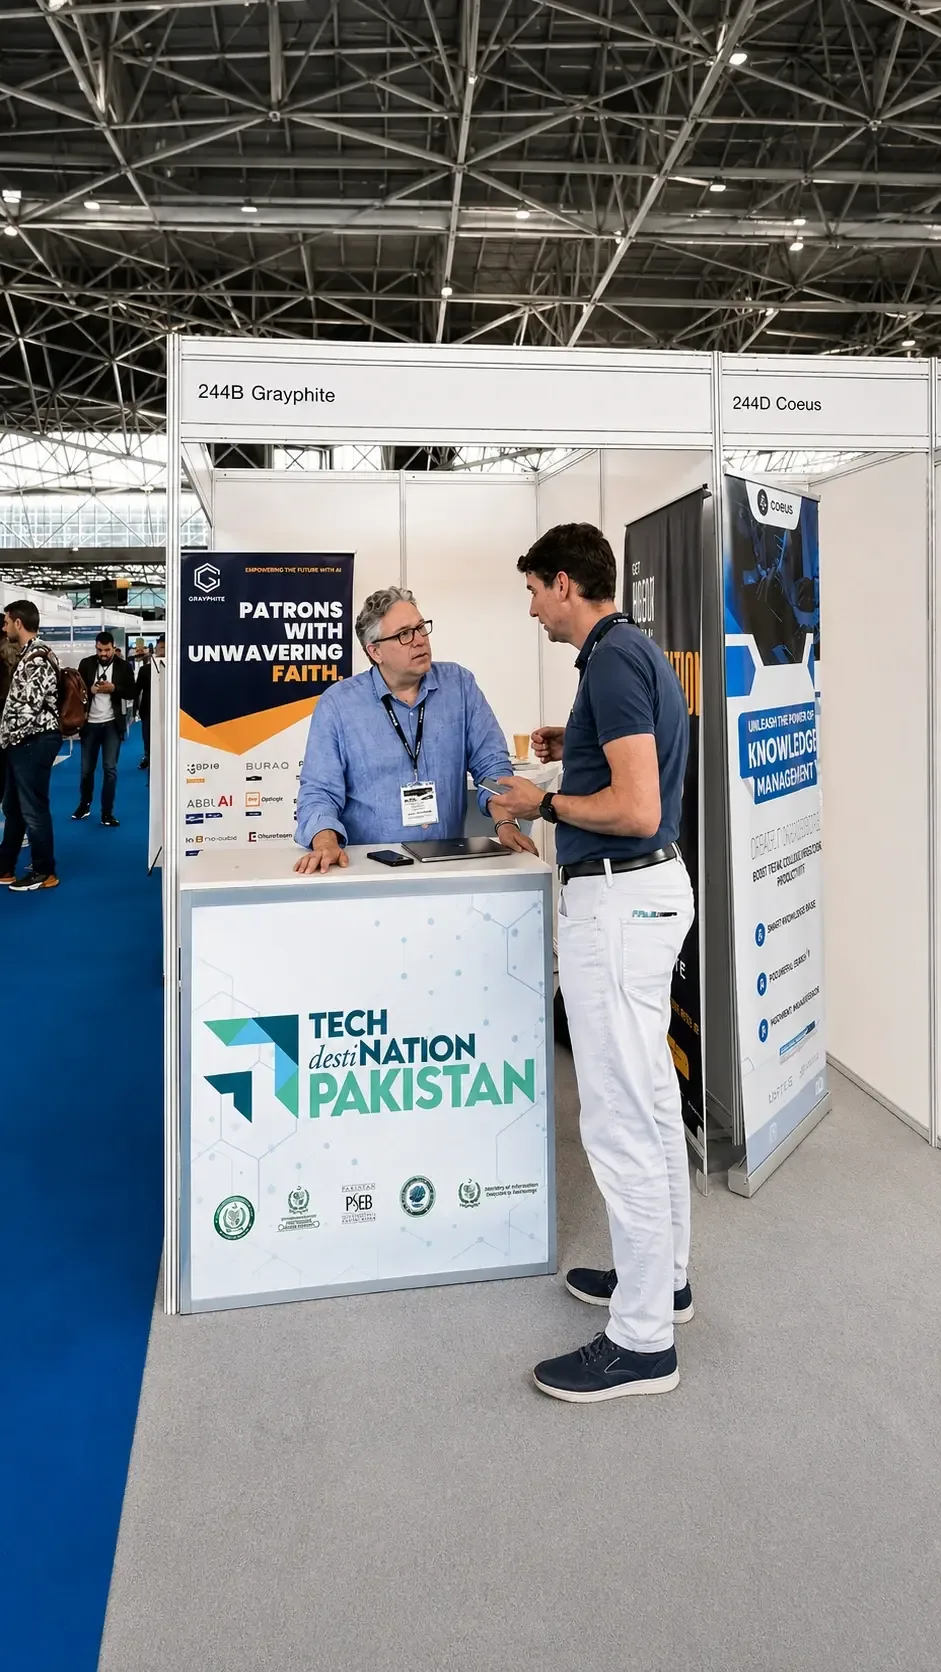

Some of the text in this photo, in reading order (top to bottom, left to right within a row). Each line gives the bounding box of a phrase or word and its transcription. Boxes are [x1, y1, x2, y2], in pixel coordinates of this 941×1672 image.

[198, 383, 336, 405] 244B Grayphite
[732, 396, 822, 411] 244D Coeus
[239, 601, 343, 619] PATRONS
[284, 622, 343, 640] WITH
[188, 643, 343, 662] UNWAVERING
[272, 664, 344, 683] FAITH.
[748, 715, 777, 733] UNLEASH
[748, 728, 816, 769] KNOWLEDGE
[757, 761, 813, 796] MANAGEMENT
[309, 1009, 387, 1039] TECH
[309, 1058, 535, 1119] PAKISTAN
[346, 1192, 373, 1212] PSEB
